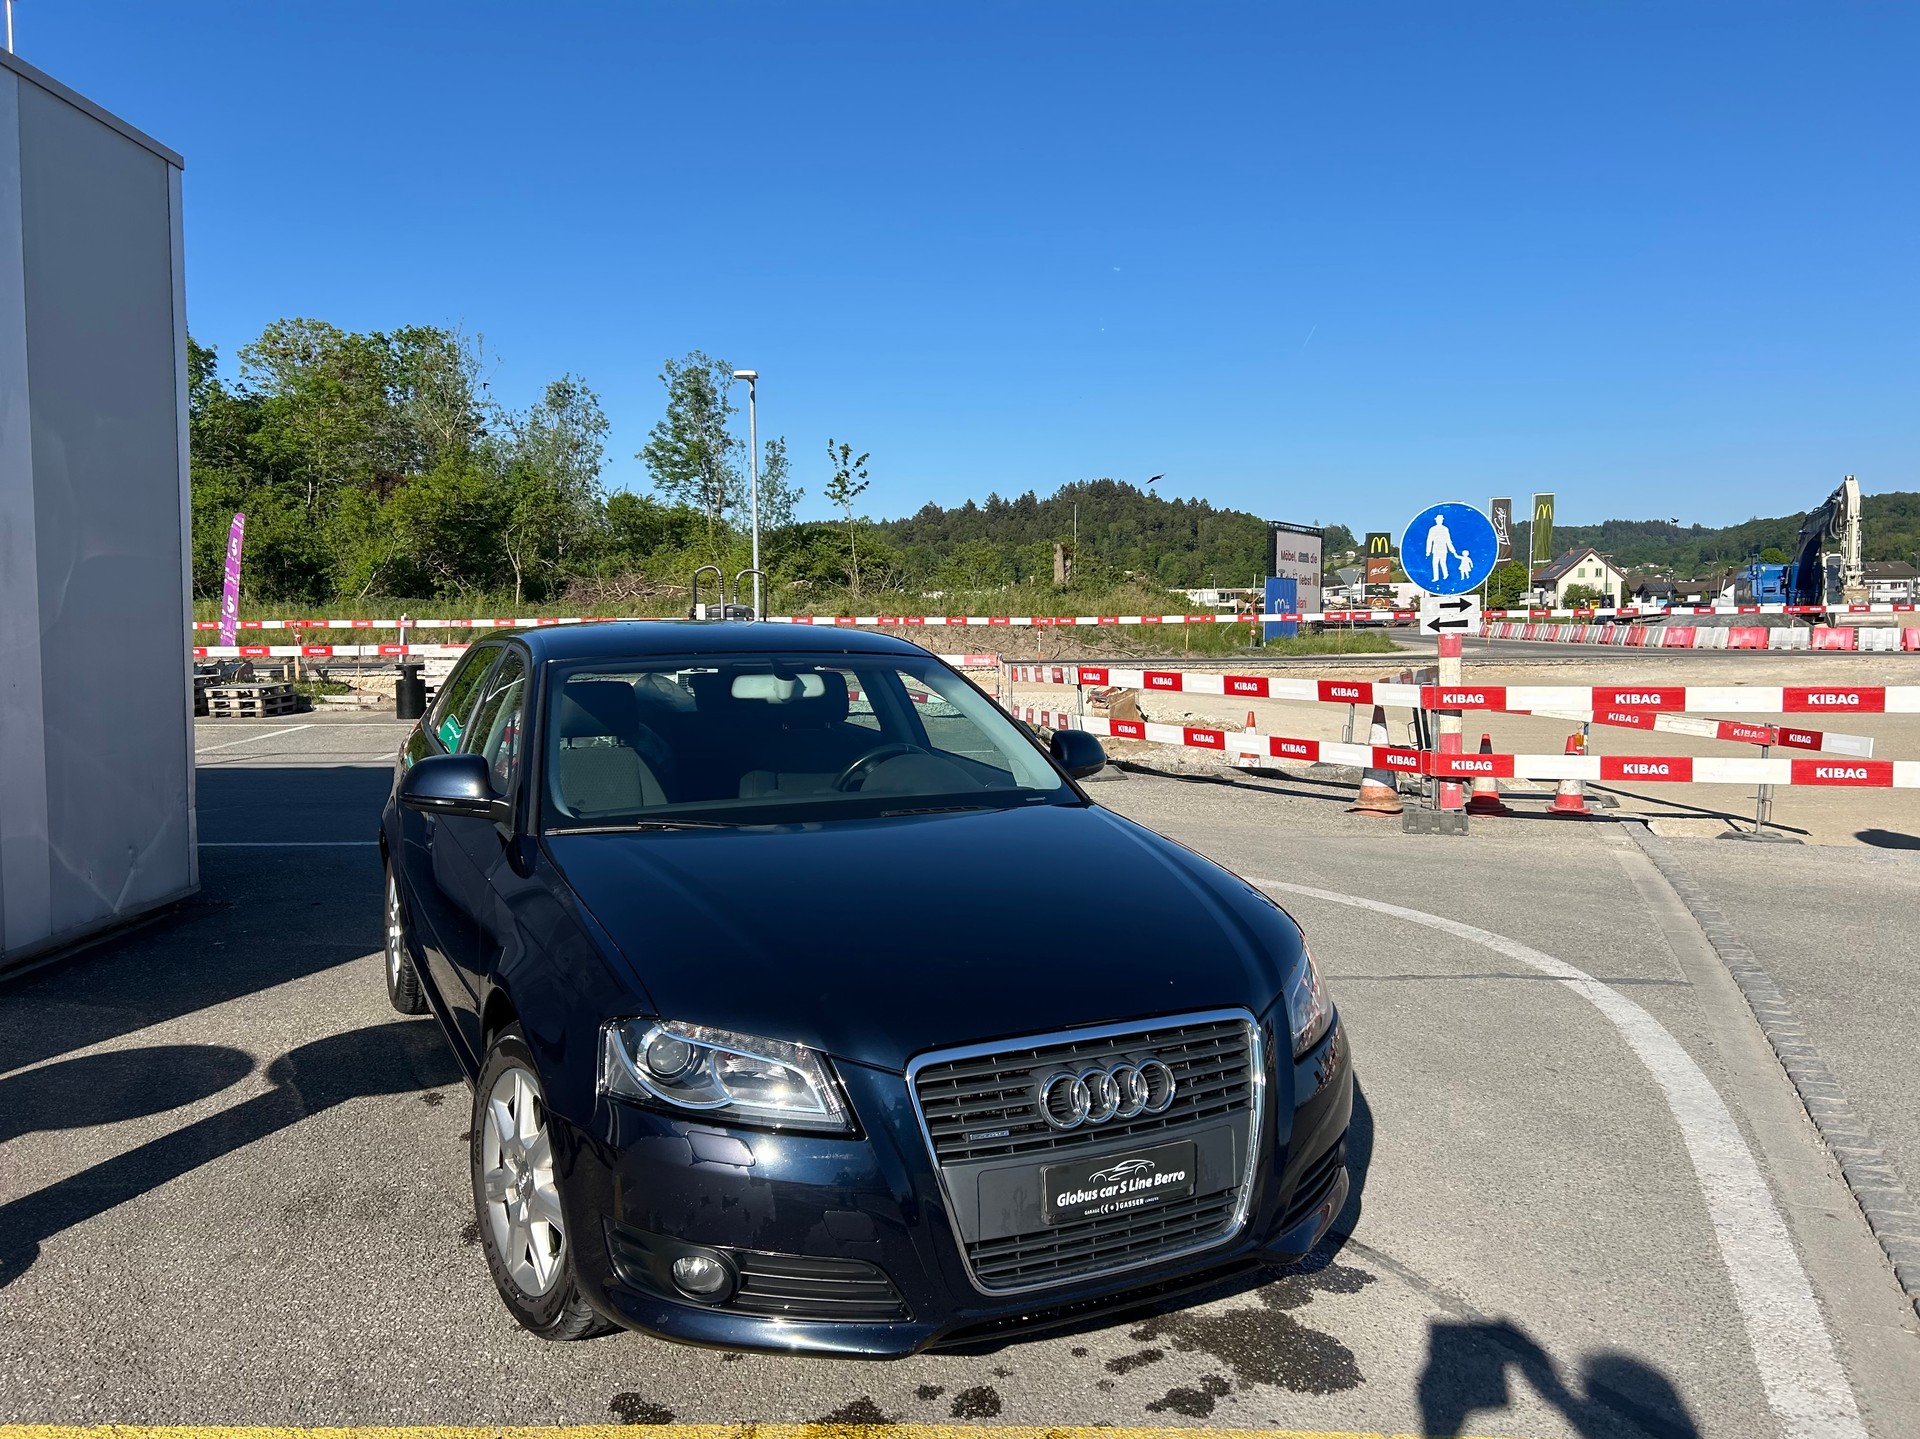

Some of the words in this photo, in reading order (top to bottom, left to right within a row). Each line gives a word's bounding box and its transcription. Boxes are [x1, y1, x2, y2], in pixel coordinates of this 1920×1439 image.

[1082, 672, 1101, 681] KIBAG
[1152, 675, 1173, 687] KIBAG
[1234, 681, 1258, 692] KIBAG
[1331, 686, 1360, 698] KIBAG
[1442, 693, 1485, 704] KIBAG
[1615, 693, 1661, 705] KIBAG
[1807, 693, 1859, 705] KIBAG
[1607, 712, 1639, 724] KIBAG
[1117, 724, 1137, 735] KIBAG
[1192, 733, 1215, 744] KIBAG
[1788, 733, 1812, 744] KIBAG
[1281, 743, 1307, 754] KIBAG
[1386, 754, 1417, 767] KIBAG
[1451, 760, 1493, 771] KIBAG
[1623, 763, 1669, 775] KIBAG
[1815, 767, 1868, 779] KIBAG
[1056, 1188, 1098, 1207] Globus
[1099, 1185, 1118, 1198] car
[1119, 1181, 1128, 1194] S
[1128, 1177, 1152, 1192] Line
[1153, 1170, 1186, 1186] Berro
[1084, 1207, 1100, 1216] GARAGE
[1119, 1198, 1144, 1210] GASSER
